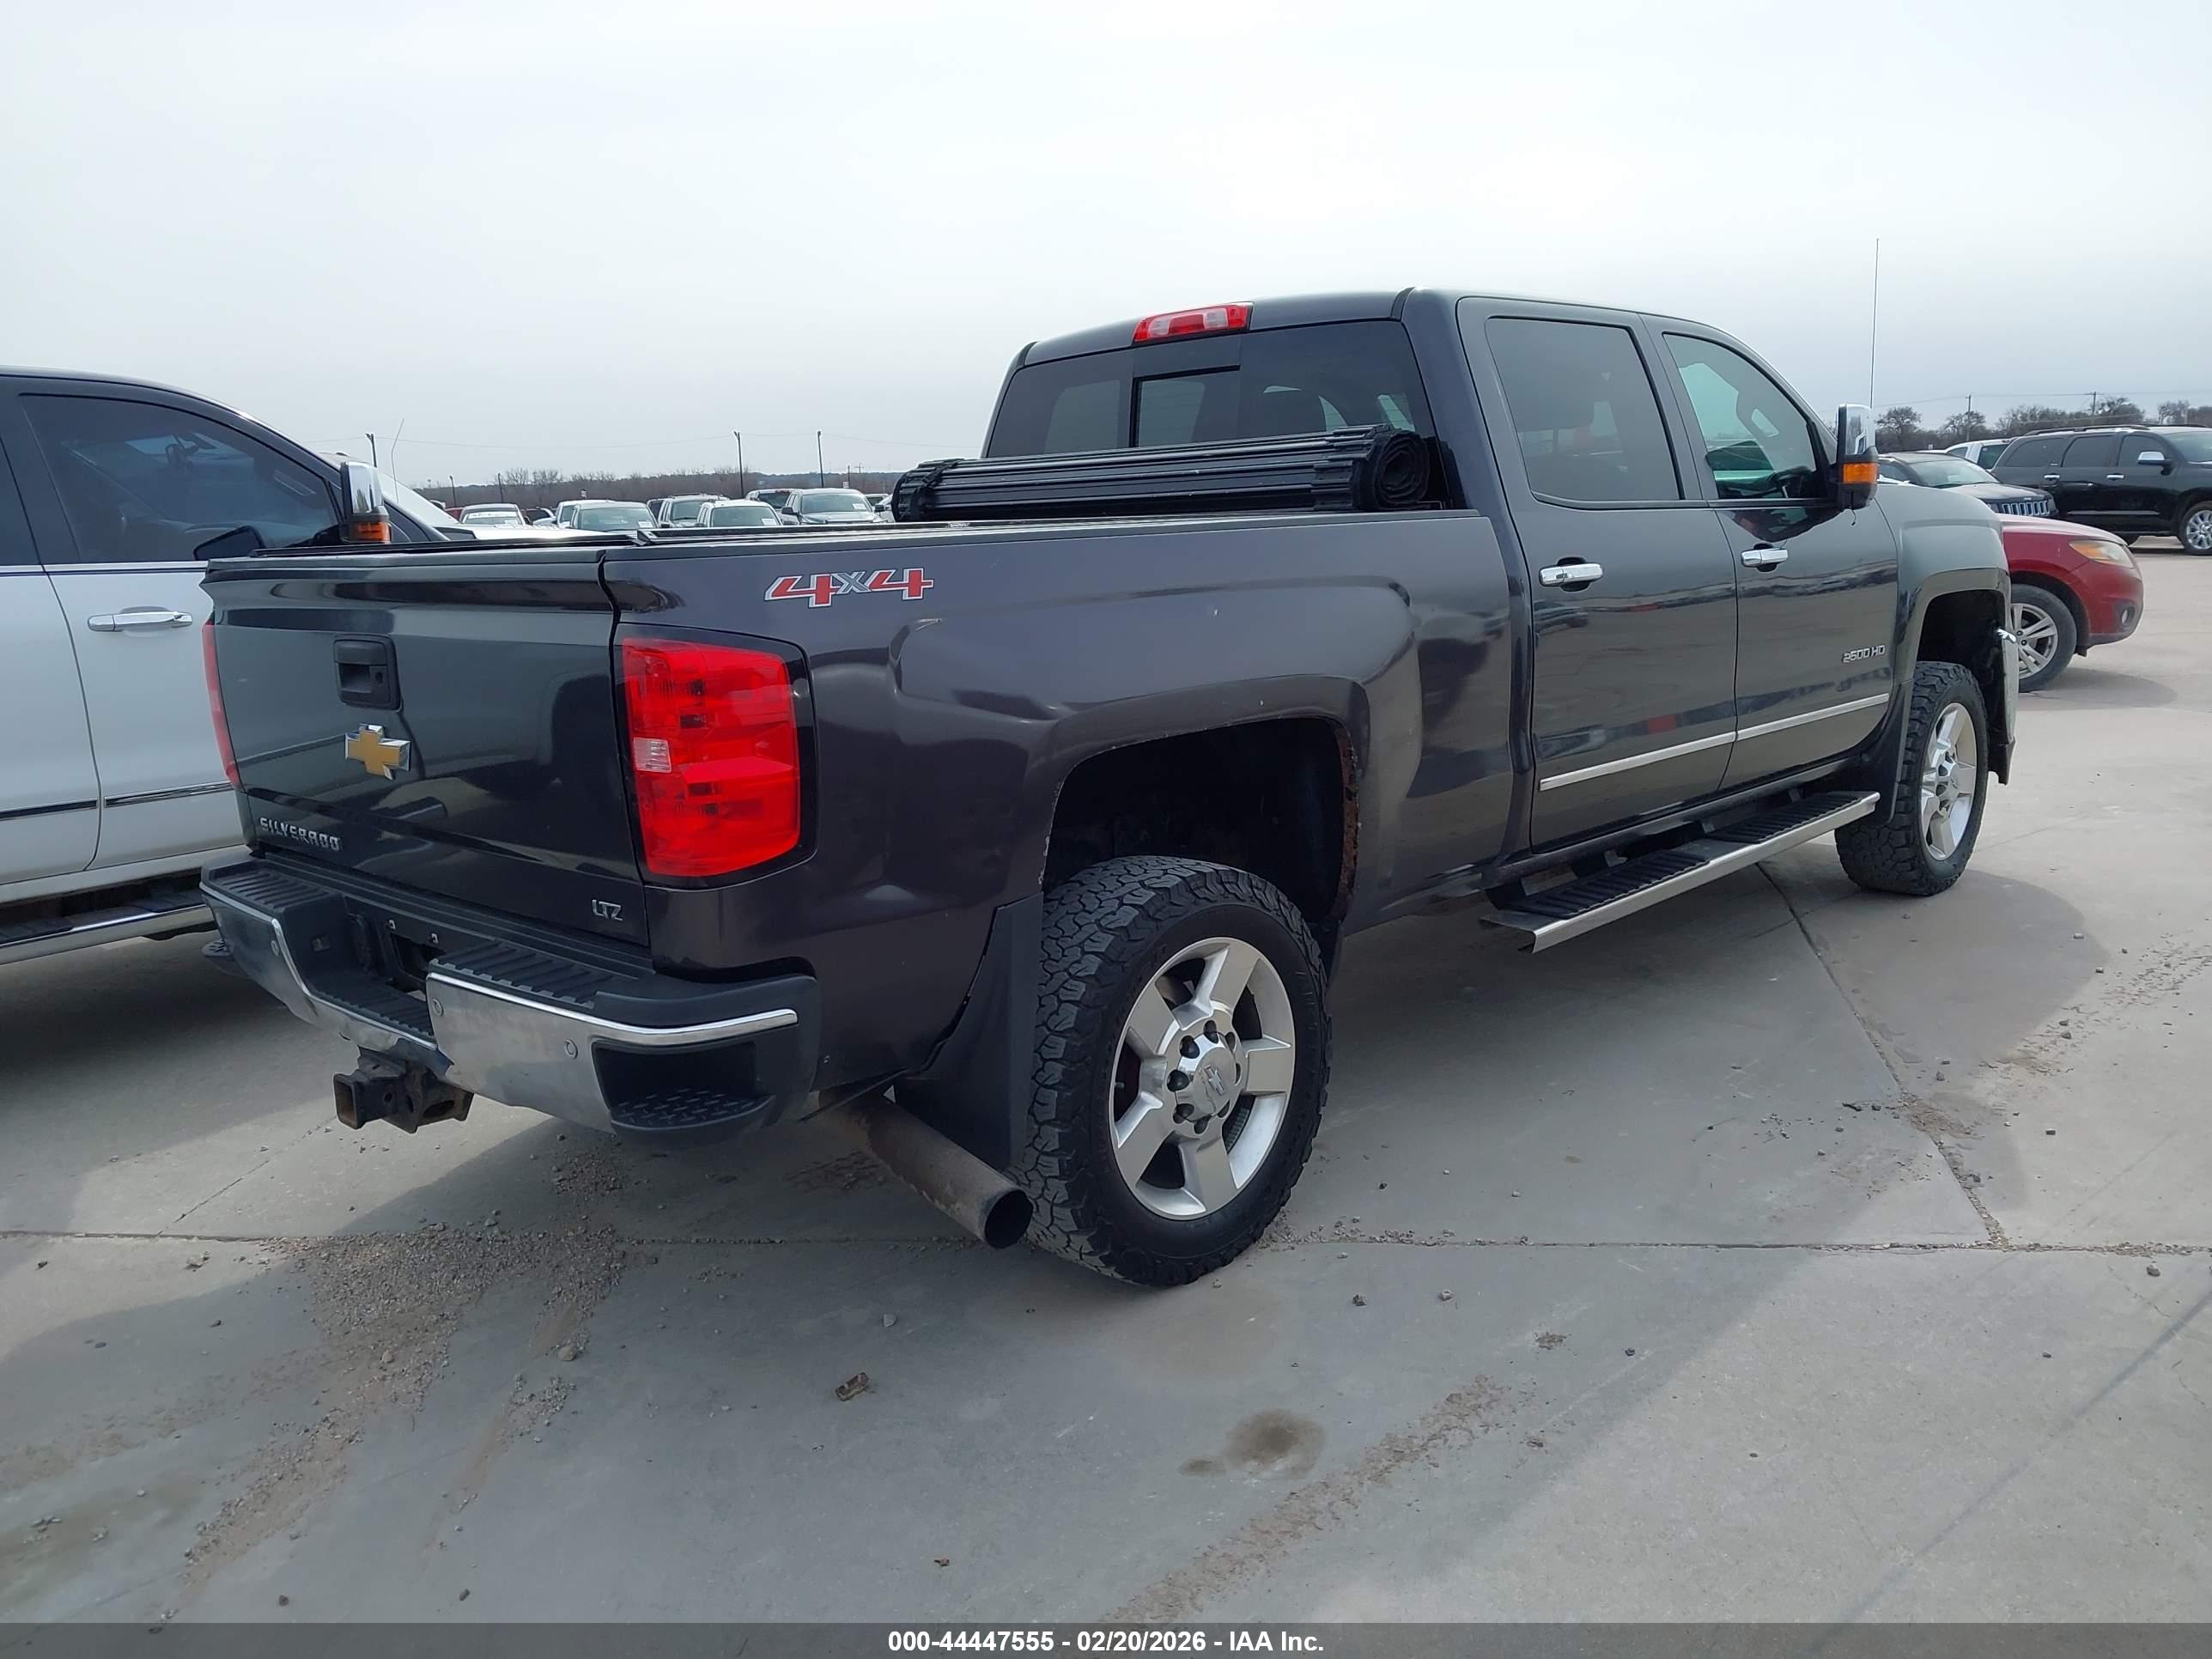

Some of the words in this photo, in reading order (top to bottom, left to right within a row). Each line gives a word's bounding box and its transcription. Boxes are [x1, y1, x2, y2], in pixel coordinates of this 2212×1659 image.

[1842, 647, 1870, 664] 2500
[1871, 645, 1886, 657] HD
[259, 817, 341, 851] SILVERADO
[592, 899, 623, 921] LTZ
